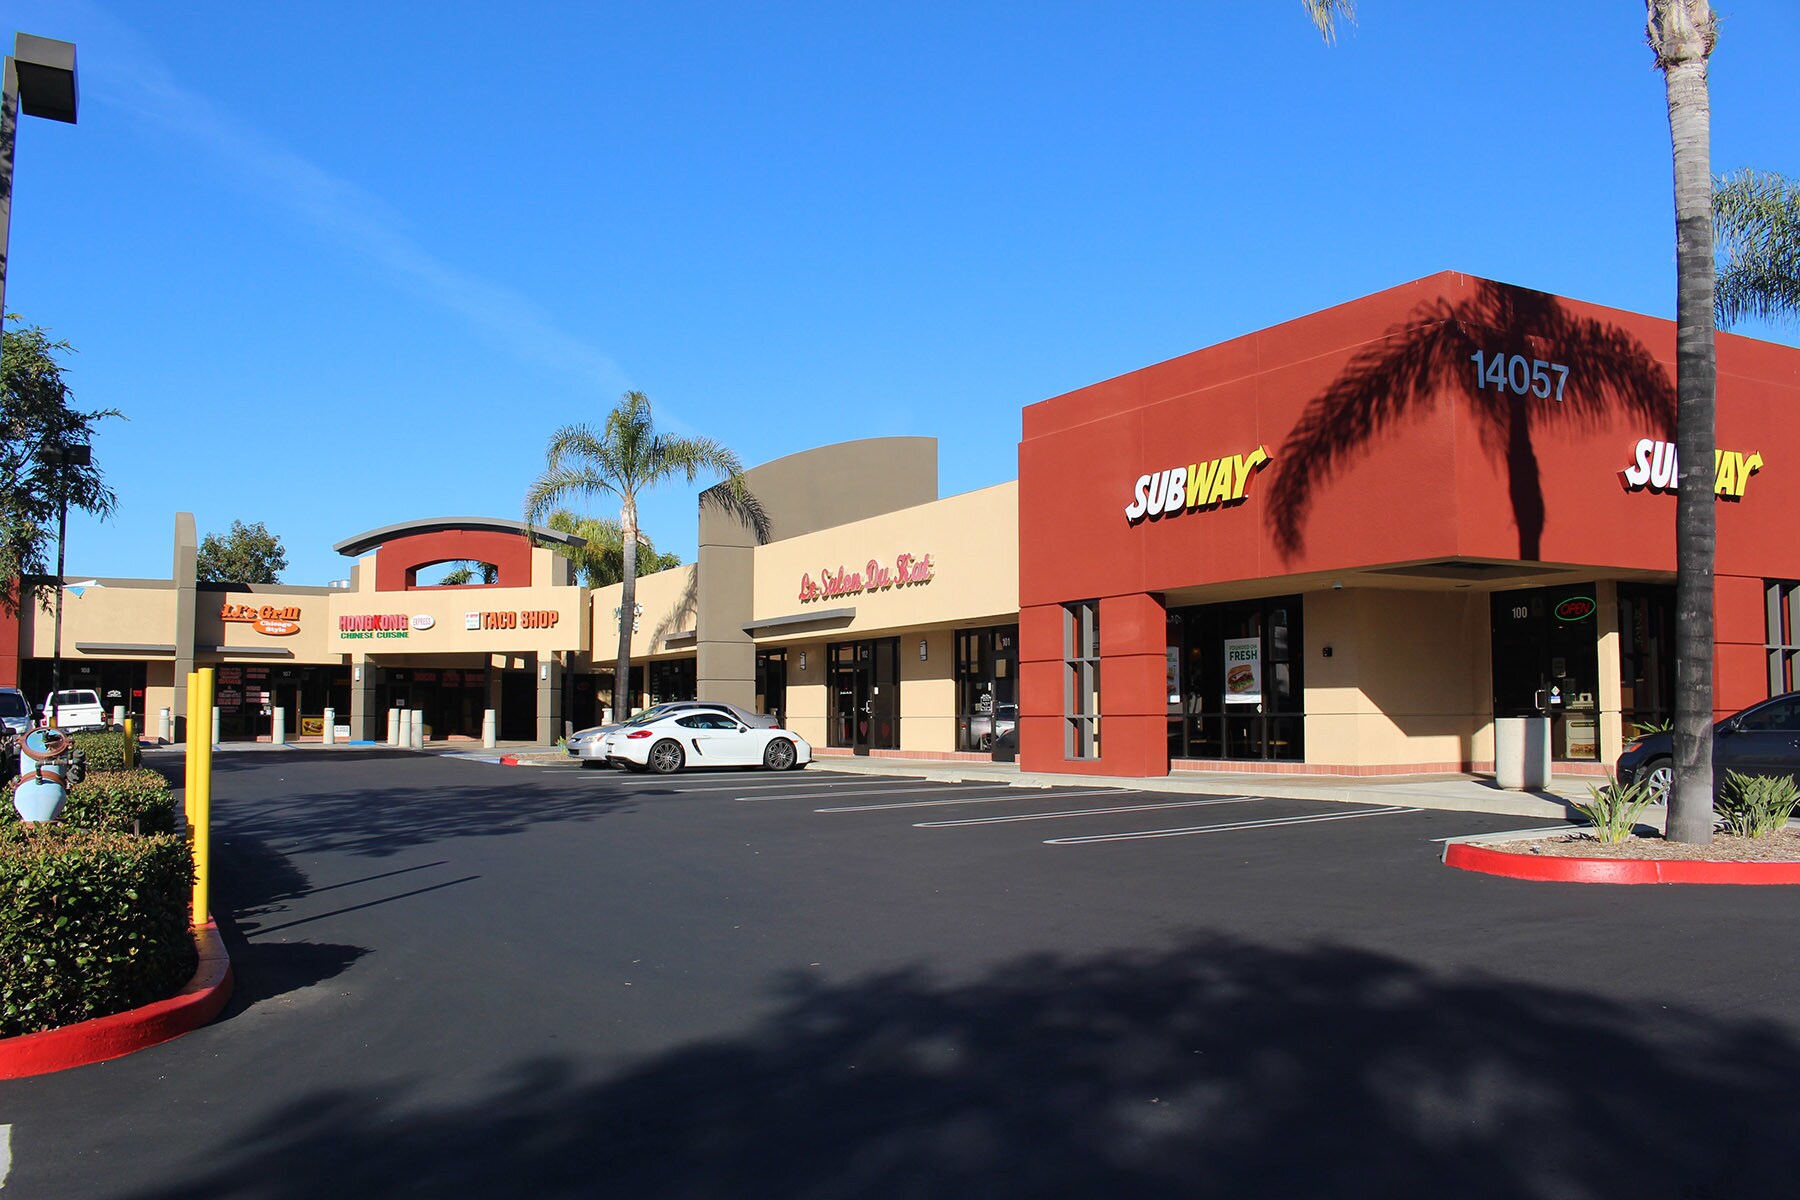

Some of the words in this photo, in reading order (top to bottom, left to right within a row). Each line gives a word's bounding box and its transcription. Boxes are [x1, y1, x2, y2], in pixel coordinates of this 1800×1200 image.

[1470, 349, 1570, 402] 14057
[1625, 438, 1764, 497] SUAY
[1125, 444, 1268, 521] SUBWAY
[799, 573, 817, 600] Le
[819, 565, 862, 596] Salon
[865, 559, 890, 589] Du
[894, 552, 931, 585] Kat
[259, 605, 299, 619] Grill
[1511, 606, 1528, 619] 100
[1559, 601, 1592, 615] OPEN
[412, 617, 432, 627] EXPRESS
[481, 611, 516, 629] TACO
[521, 610, 558, 628] SHOP
[376, 631, 409, 639] CUISINE
[1229, 650, 1258, 661] FRESH
